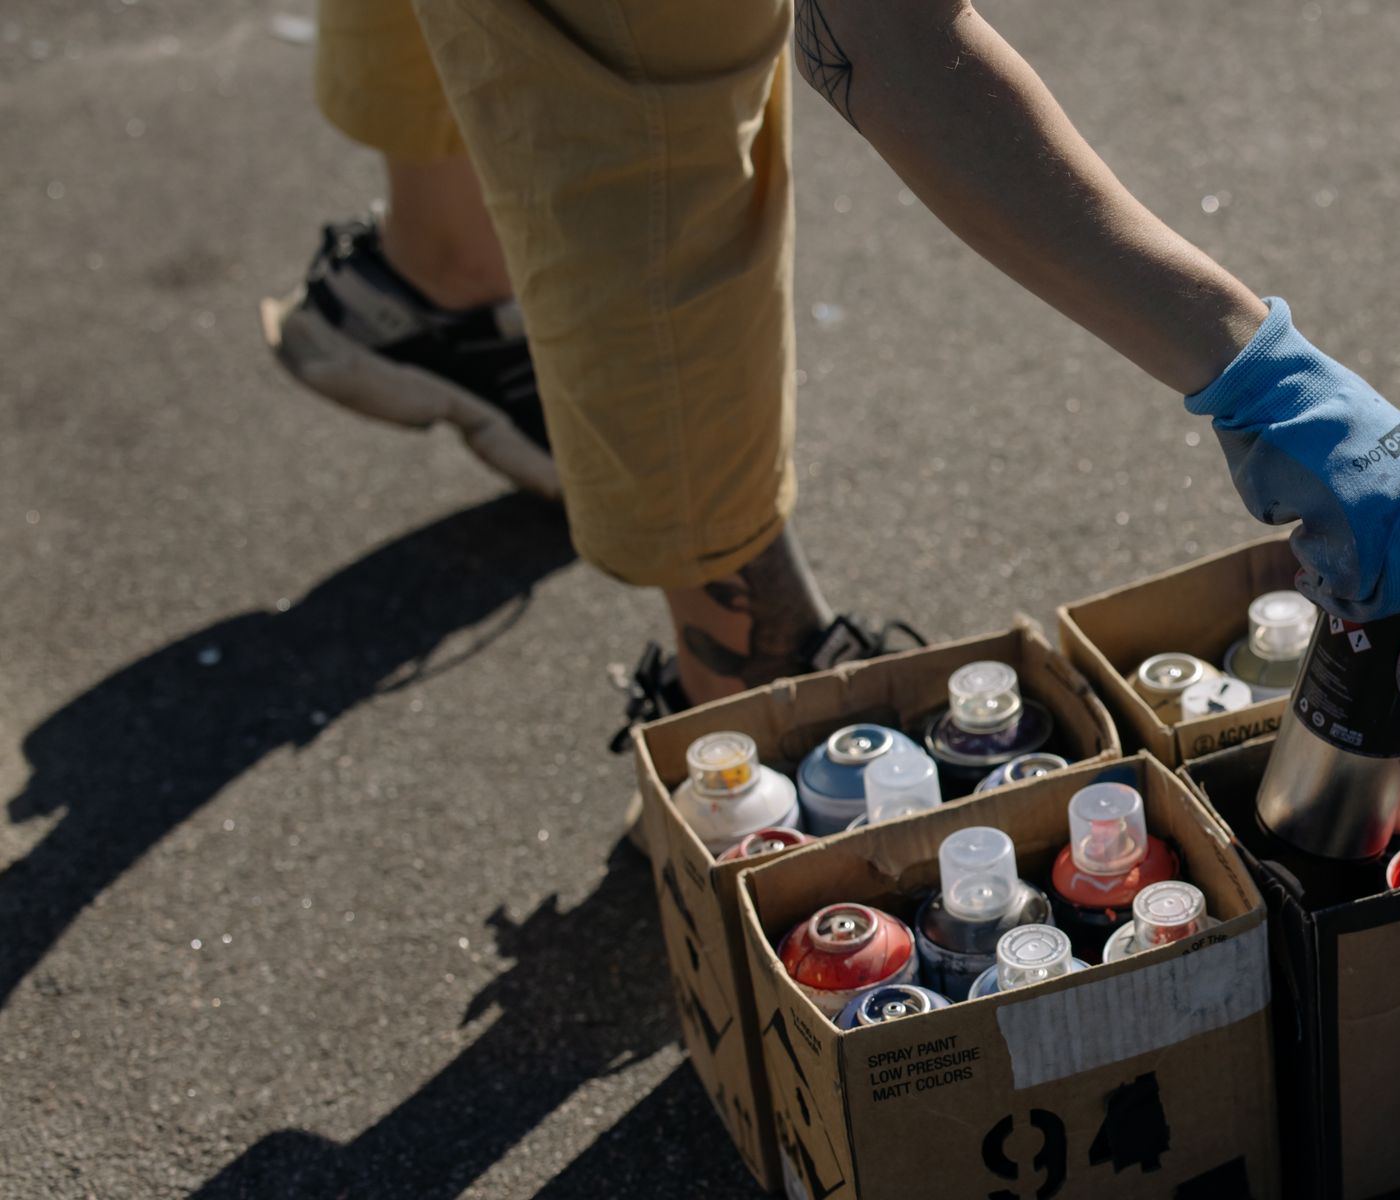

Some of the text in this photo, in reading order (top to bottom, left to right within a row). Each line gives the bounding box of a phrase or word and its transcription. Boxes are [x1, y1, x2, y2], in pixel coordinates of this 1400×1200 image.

[868, 1035, 957, 1068] SPRAY PAINT
[870, 1047, 981, 1086] LOW PRESSURE
[873, 1066, 973, 1102] MATT COLORS
